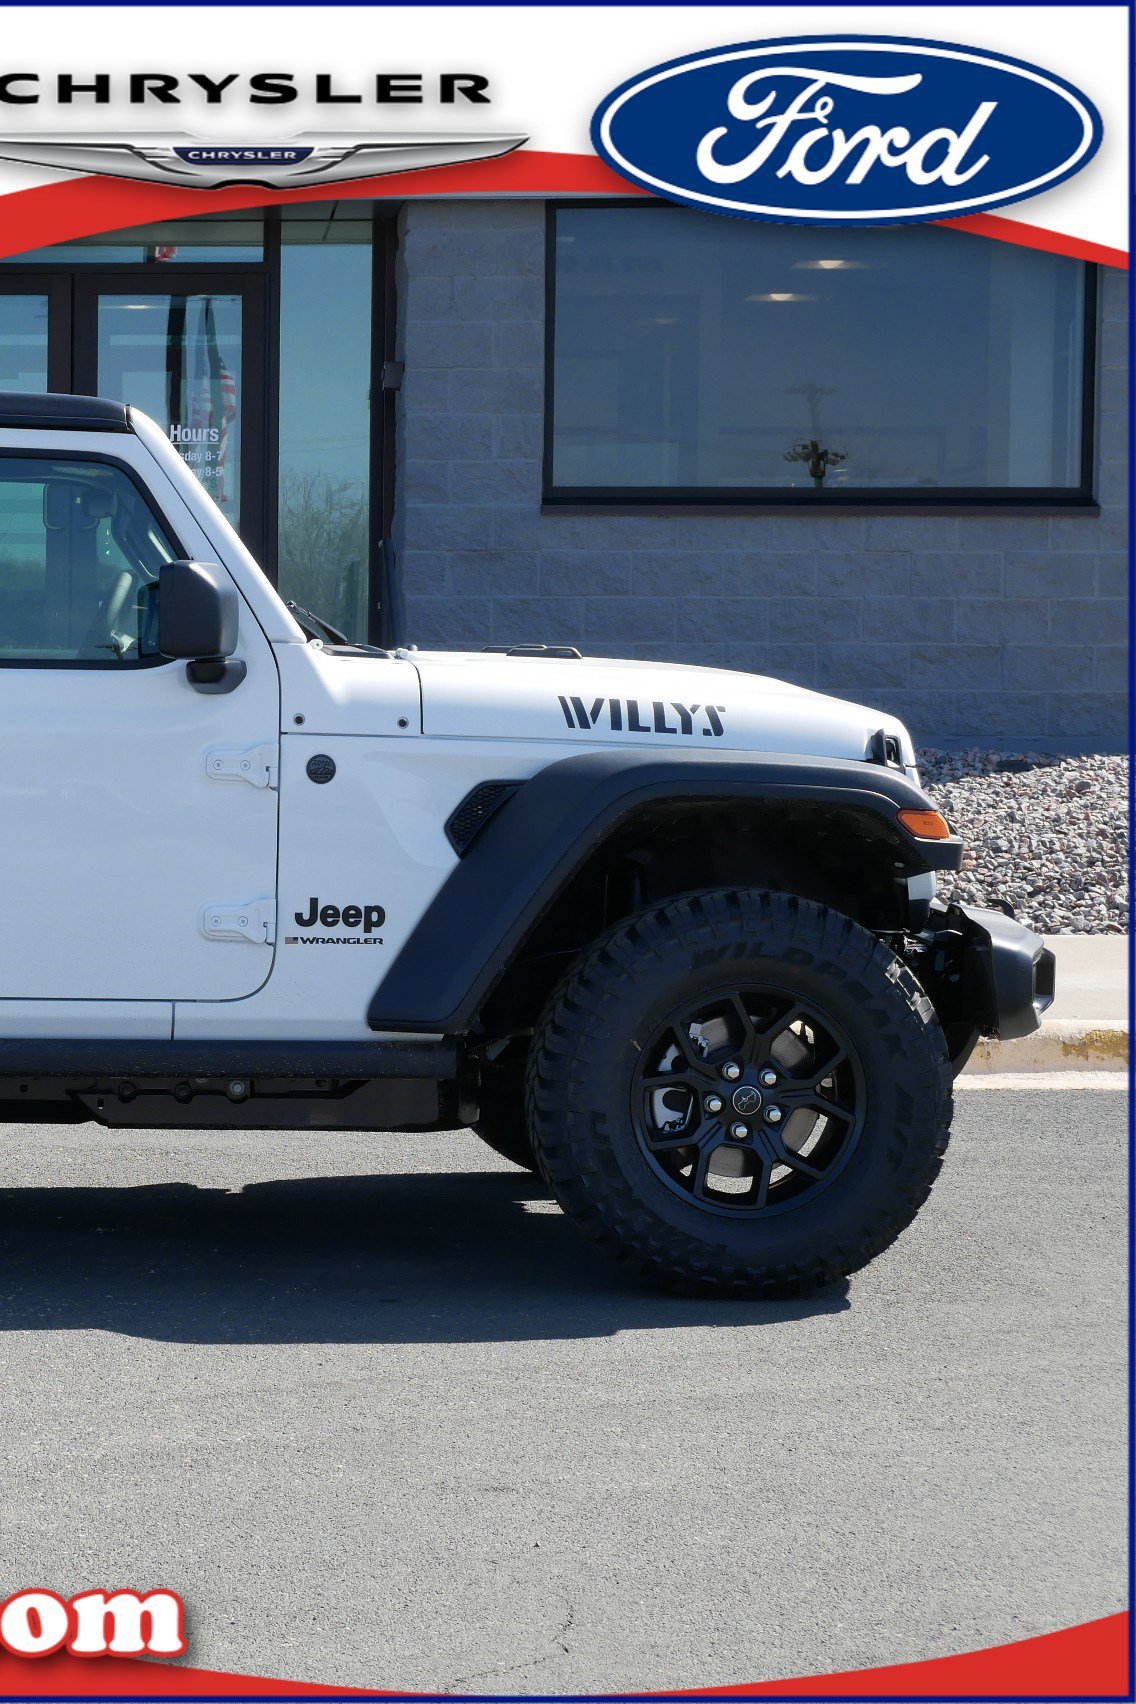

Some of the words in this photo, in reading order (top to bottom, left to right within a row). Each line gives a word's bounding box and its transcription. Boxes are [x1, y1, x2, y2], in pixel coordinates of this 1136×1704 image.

[170, 424, 219, 441] Hours
[557, 695, 726, 737] WILLYS
[294, 897, 386, 933] Jeep
[299, 937, 384, 945] WRANGLER
